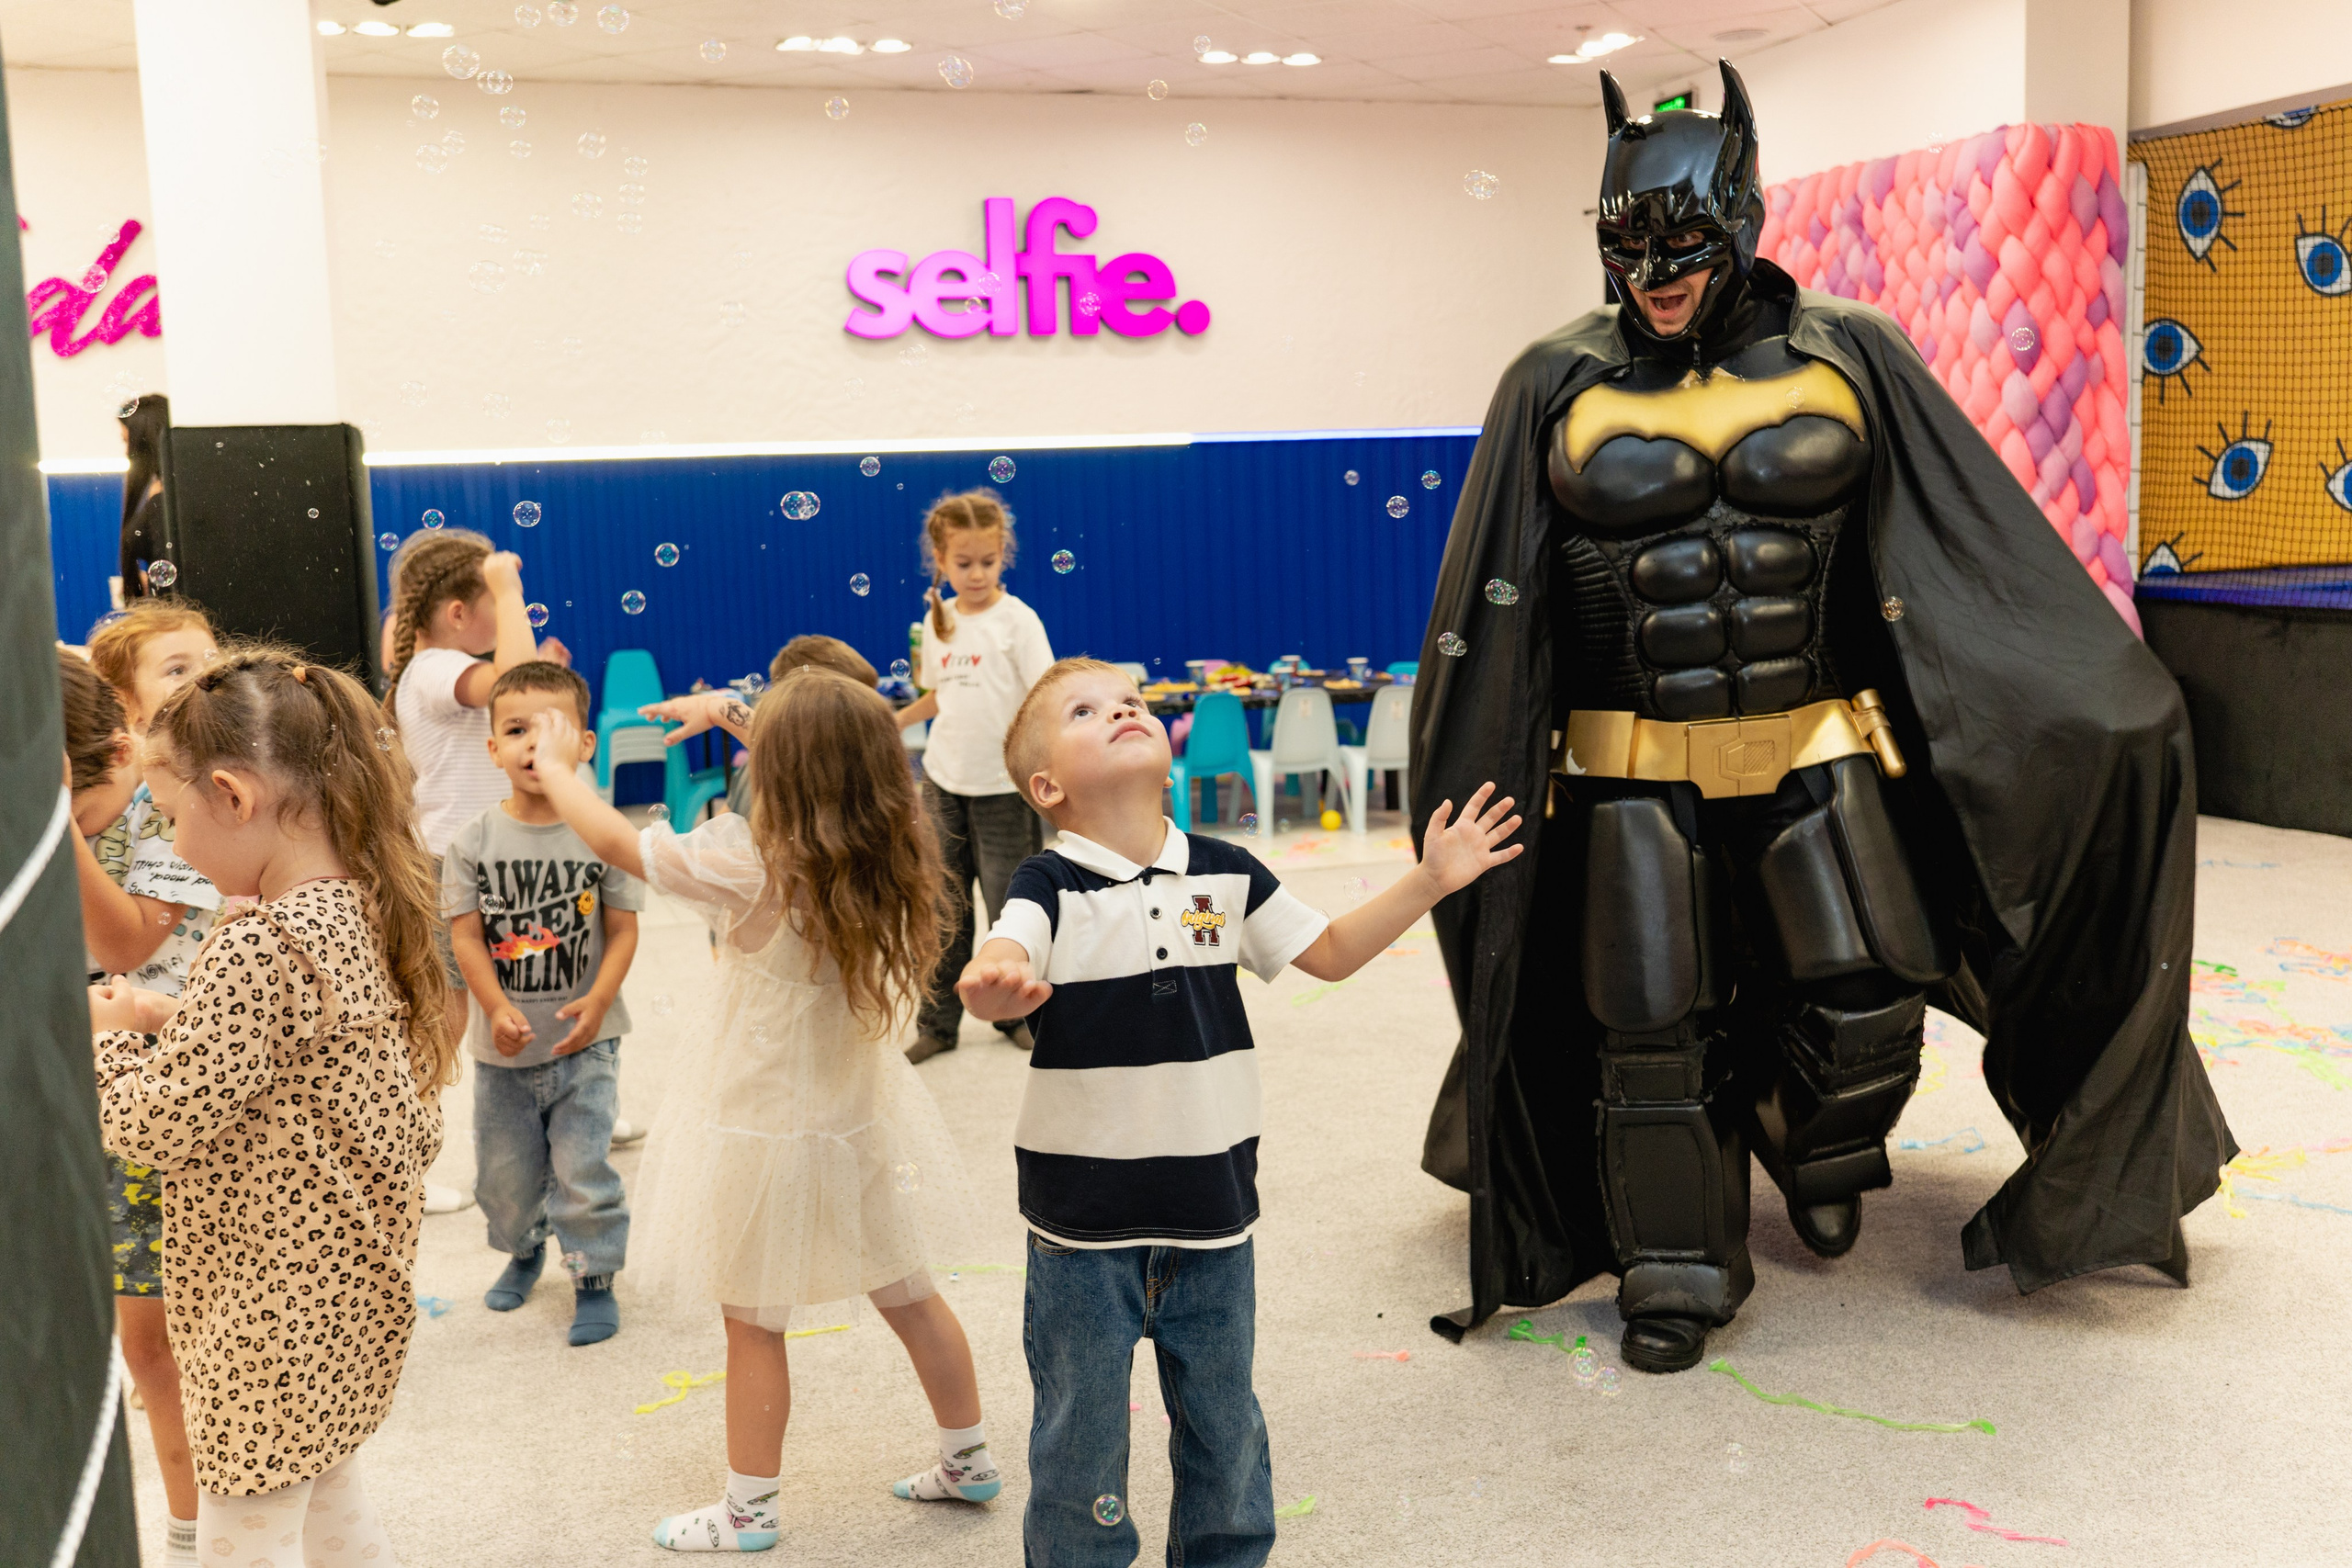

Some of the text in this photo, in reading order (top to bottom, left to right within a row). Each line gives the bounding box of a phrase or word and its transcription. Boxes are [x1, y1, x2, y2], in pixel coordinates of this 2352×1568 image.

[843, 197, 1211, 339] selfie.
[477, 859, 604, 910] ALWAYS
[494, 929, 591, 993] MILING
